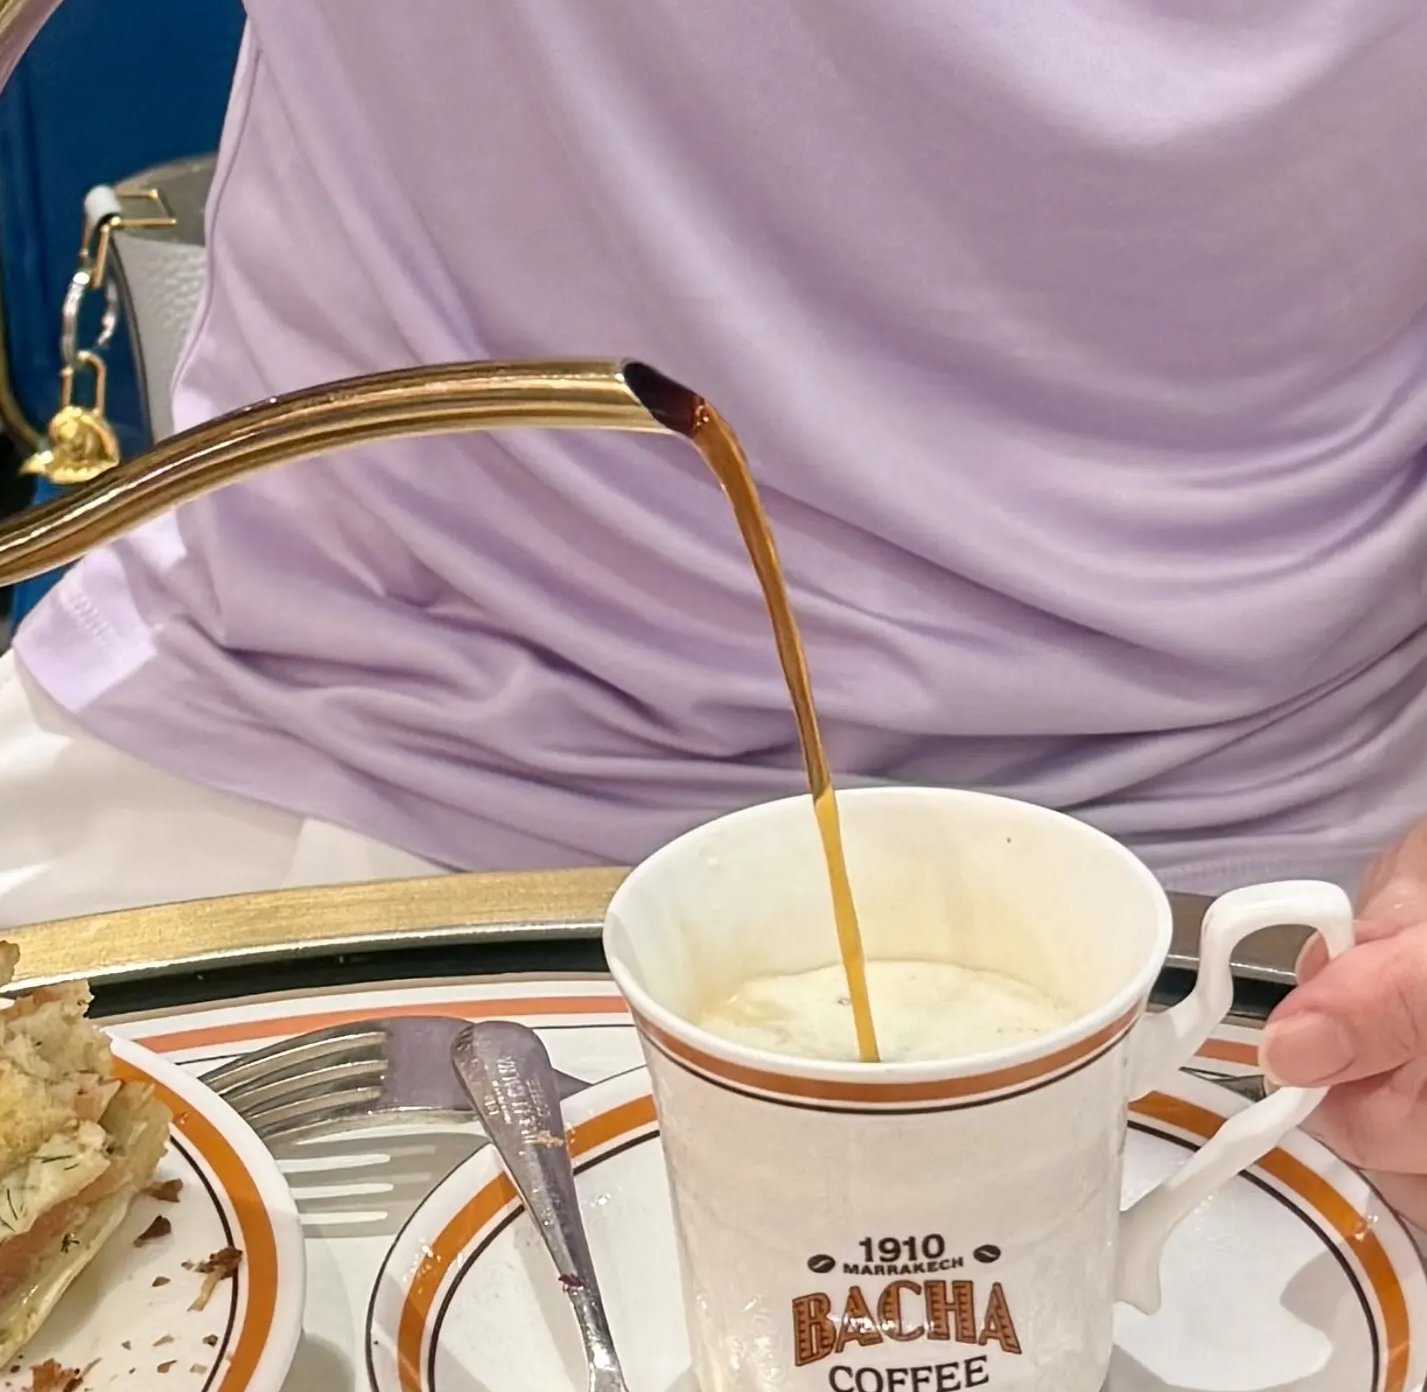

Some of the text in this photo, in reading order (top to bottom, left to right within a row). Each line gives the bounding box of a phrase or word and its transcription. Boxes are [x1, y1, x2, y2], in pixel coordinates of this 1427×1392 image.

[859, 1233, 946, 1263] 1910
[843, 1256, 965, 1276] MARRAKECH
[792, 1279, 1023, 1367] BACHA
